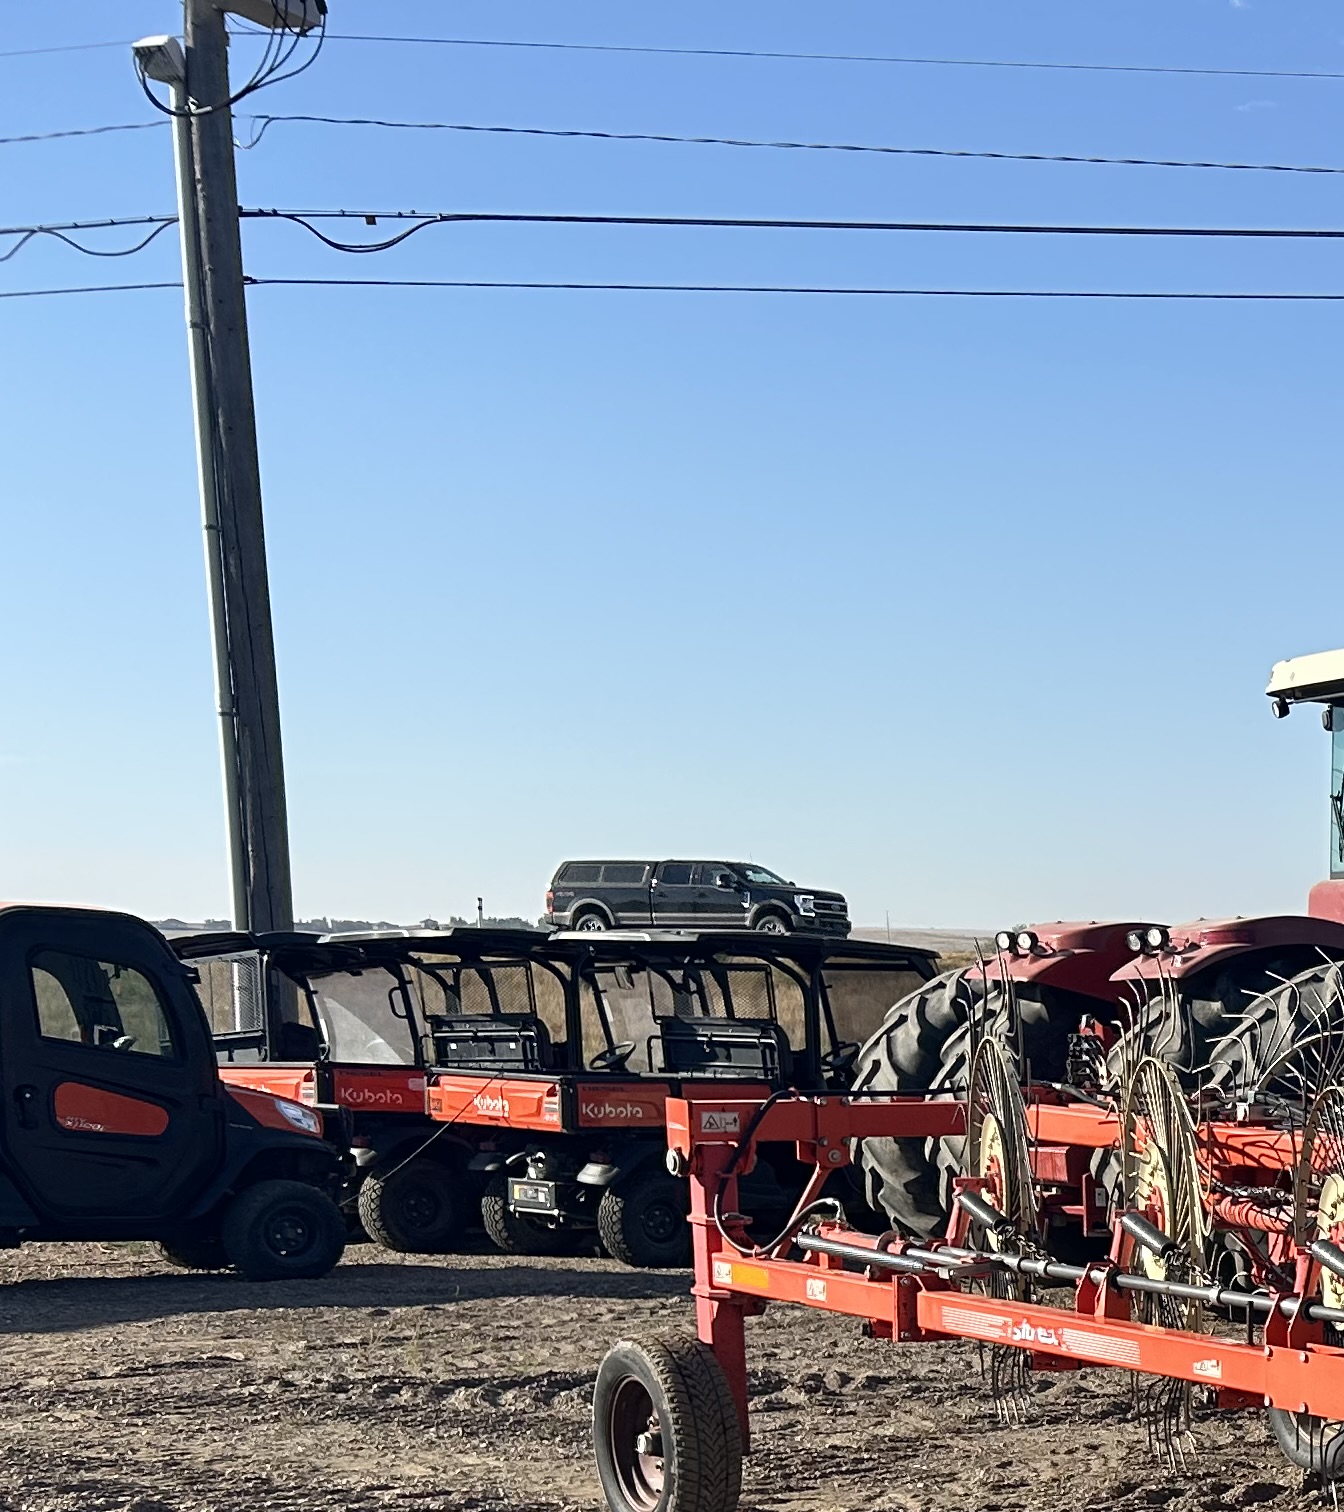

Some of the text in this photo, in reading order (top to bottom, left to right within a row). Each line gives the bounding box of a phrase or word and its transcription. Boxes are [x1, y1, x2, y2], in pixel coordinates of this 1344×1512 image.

[341, 1088, 403, 1105] Kubota
[473, 1094, 510, 1112] Kubota
[582, 1103, 643, 1119] Kubota
